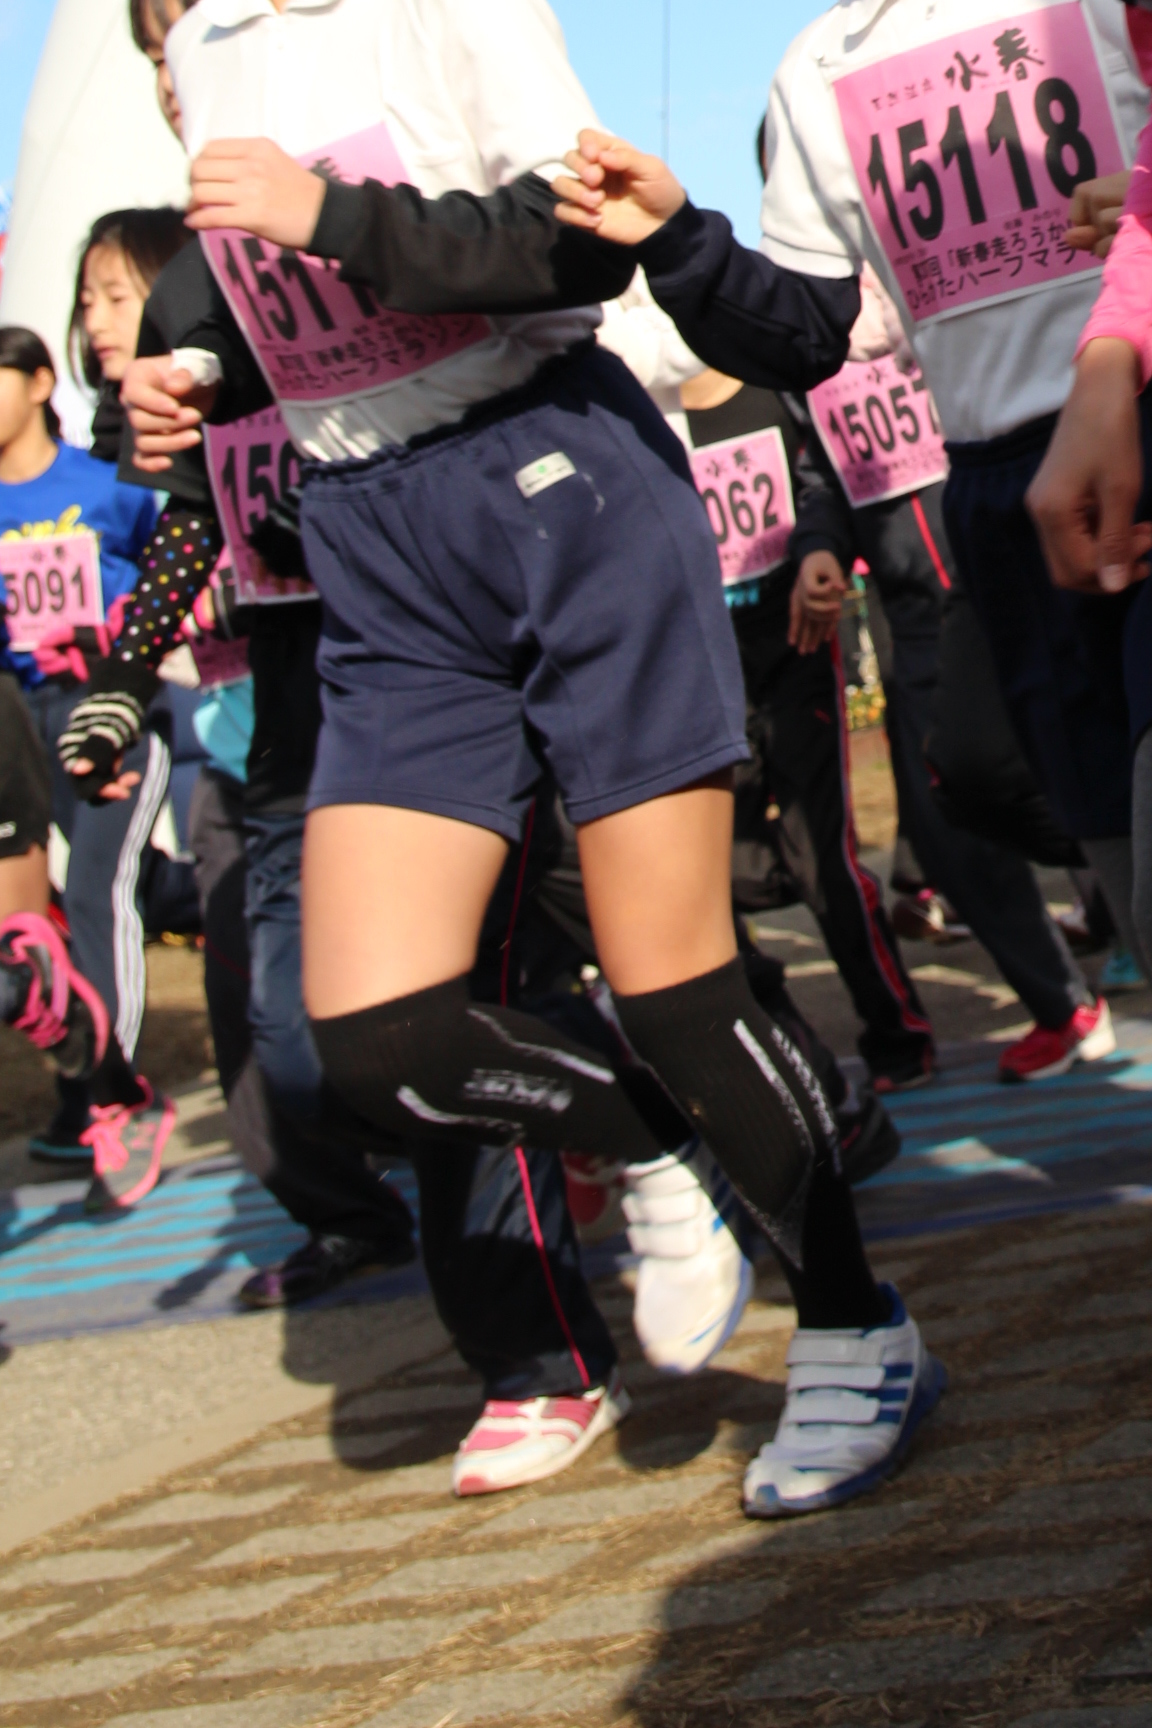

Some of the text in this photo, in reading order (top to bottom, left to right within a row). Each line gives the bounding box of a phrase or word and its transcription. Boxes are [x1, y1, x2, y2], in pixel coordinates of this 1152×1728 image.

[945, 28, 1044, 92] 水春
[867, 77, 1097, 250] 15118
[702, 473, 778, 544] 062
[5, 565, 86, 617] 5091
